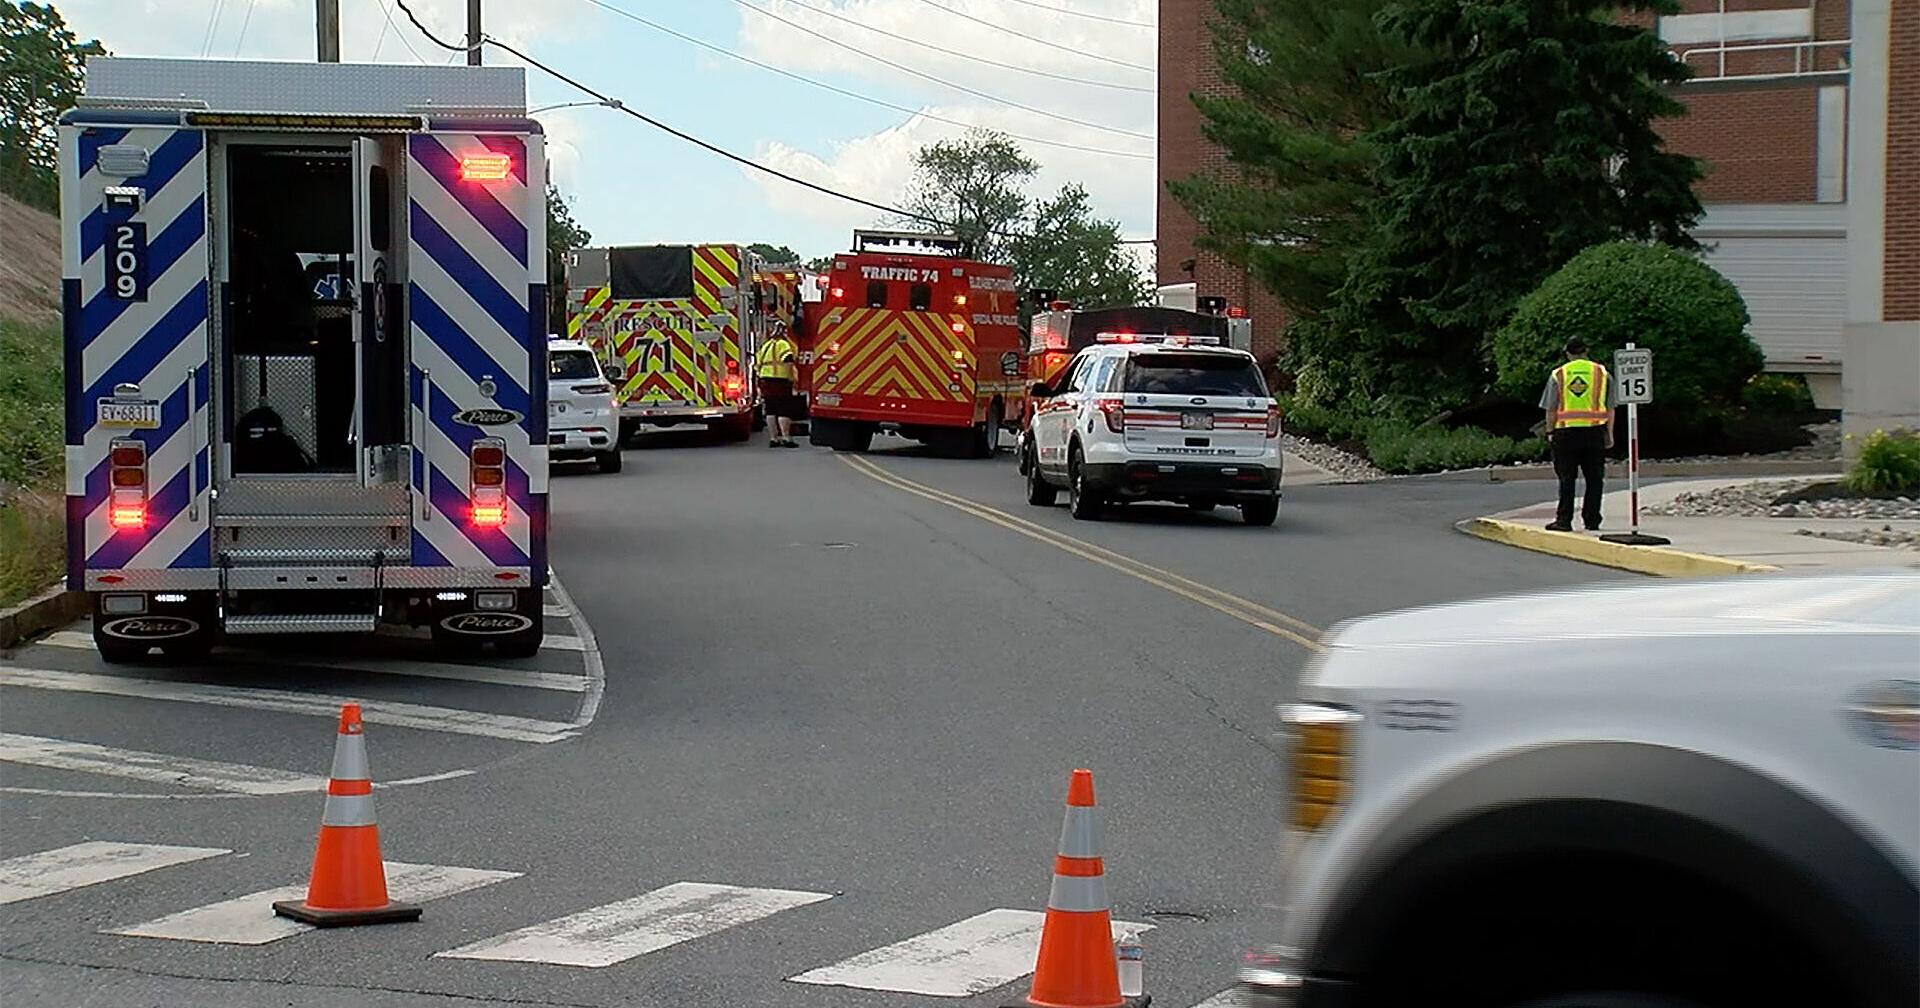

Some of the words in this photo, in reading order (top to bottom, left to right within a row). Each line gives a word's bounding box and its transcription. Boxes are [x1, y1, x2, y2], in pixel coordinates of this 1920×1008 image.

[116, 226, 137, 298] 209
[860, 265, 918, 282] TRAFFIC
[921, 269, 939, 283] 74
[619, 316, 691, 332] RESCUE
[634, 336, 672, 373] 71
[1618, 355, 1648, 365] SPEED
[1621, 366, 1645, 375] LIMIT
[1621, 378, 1646, 396] 15
[468, 410, 508, 423] Pierce
[457, 615, 518, 629] Pierce
